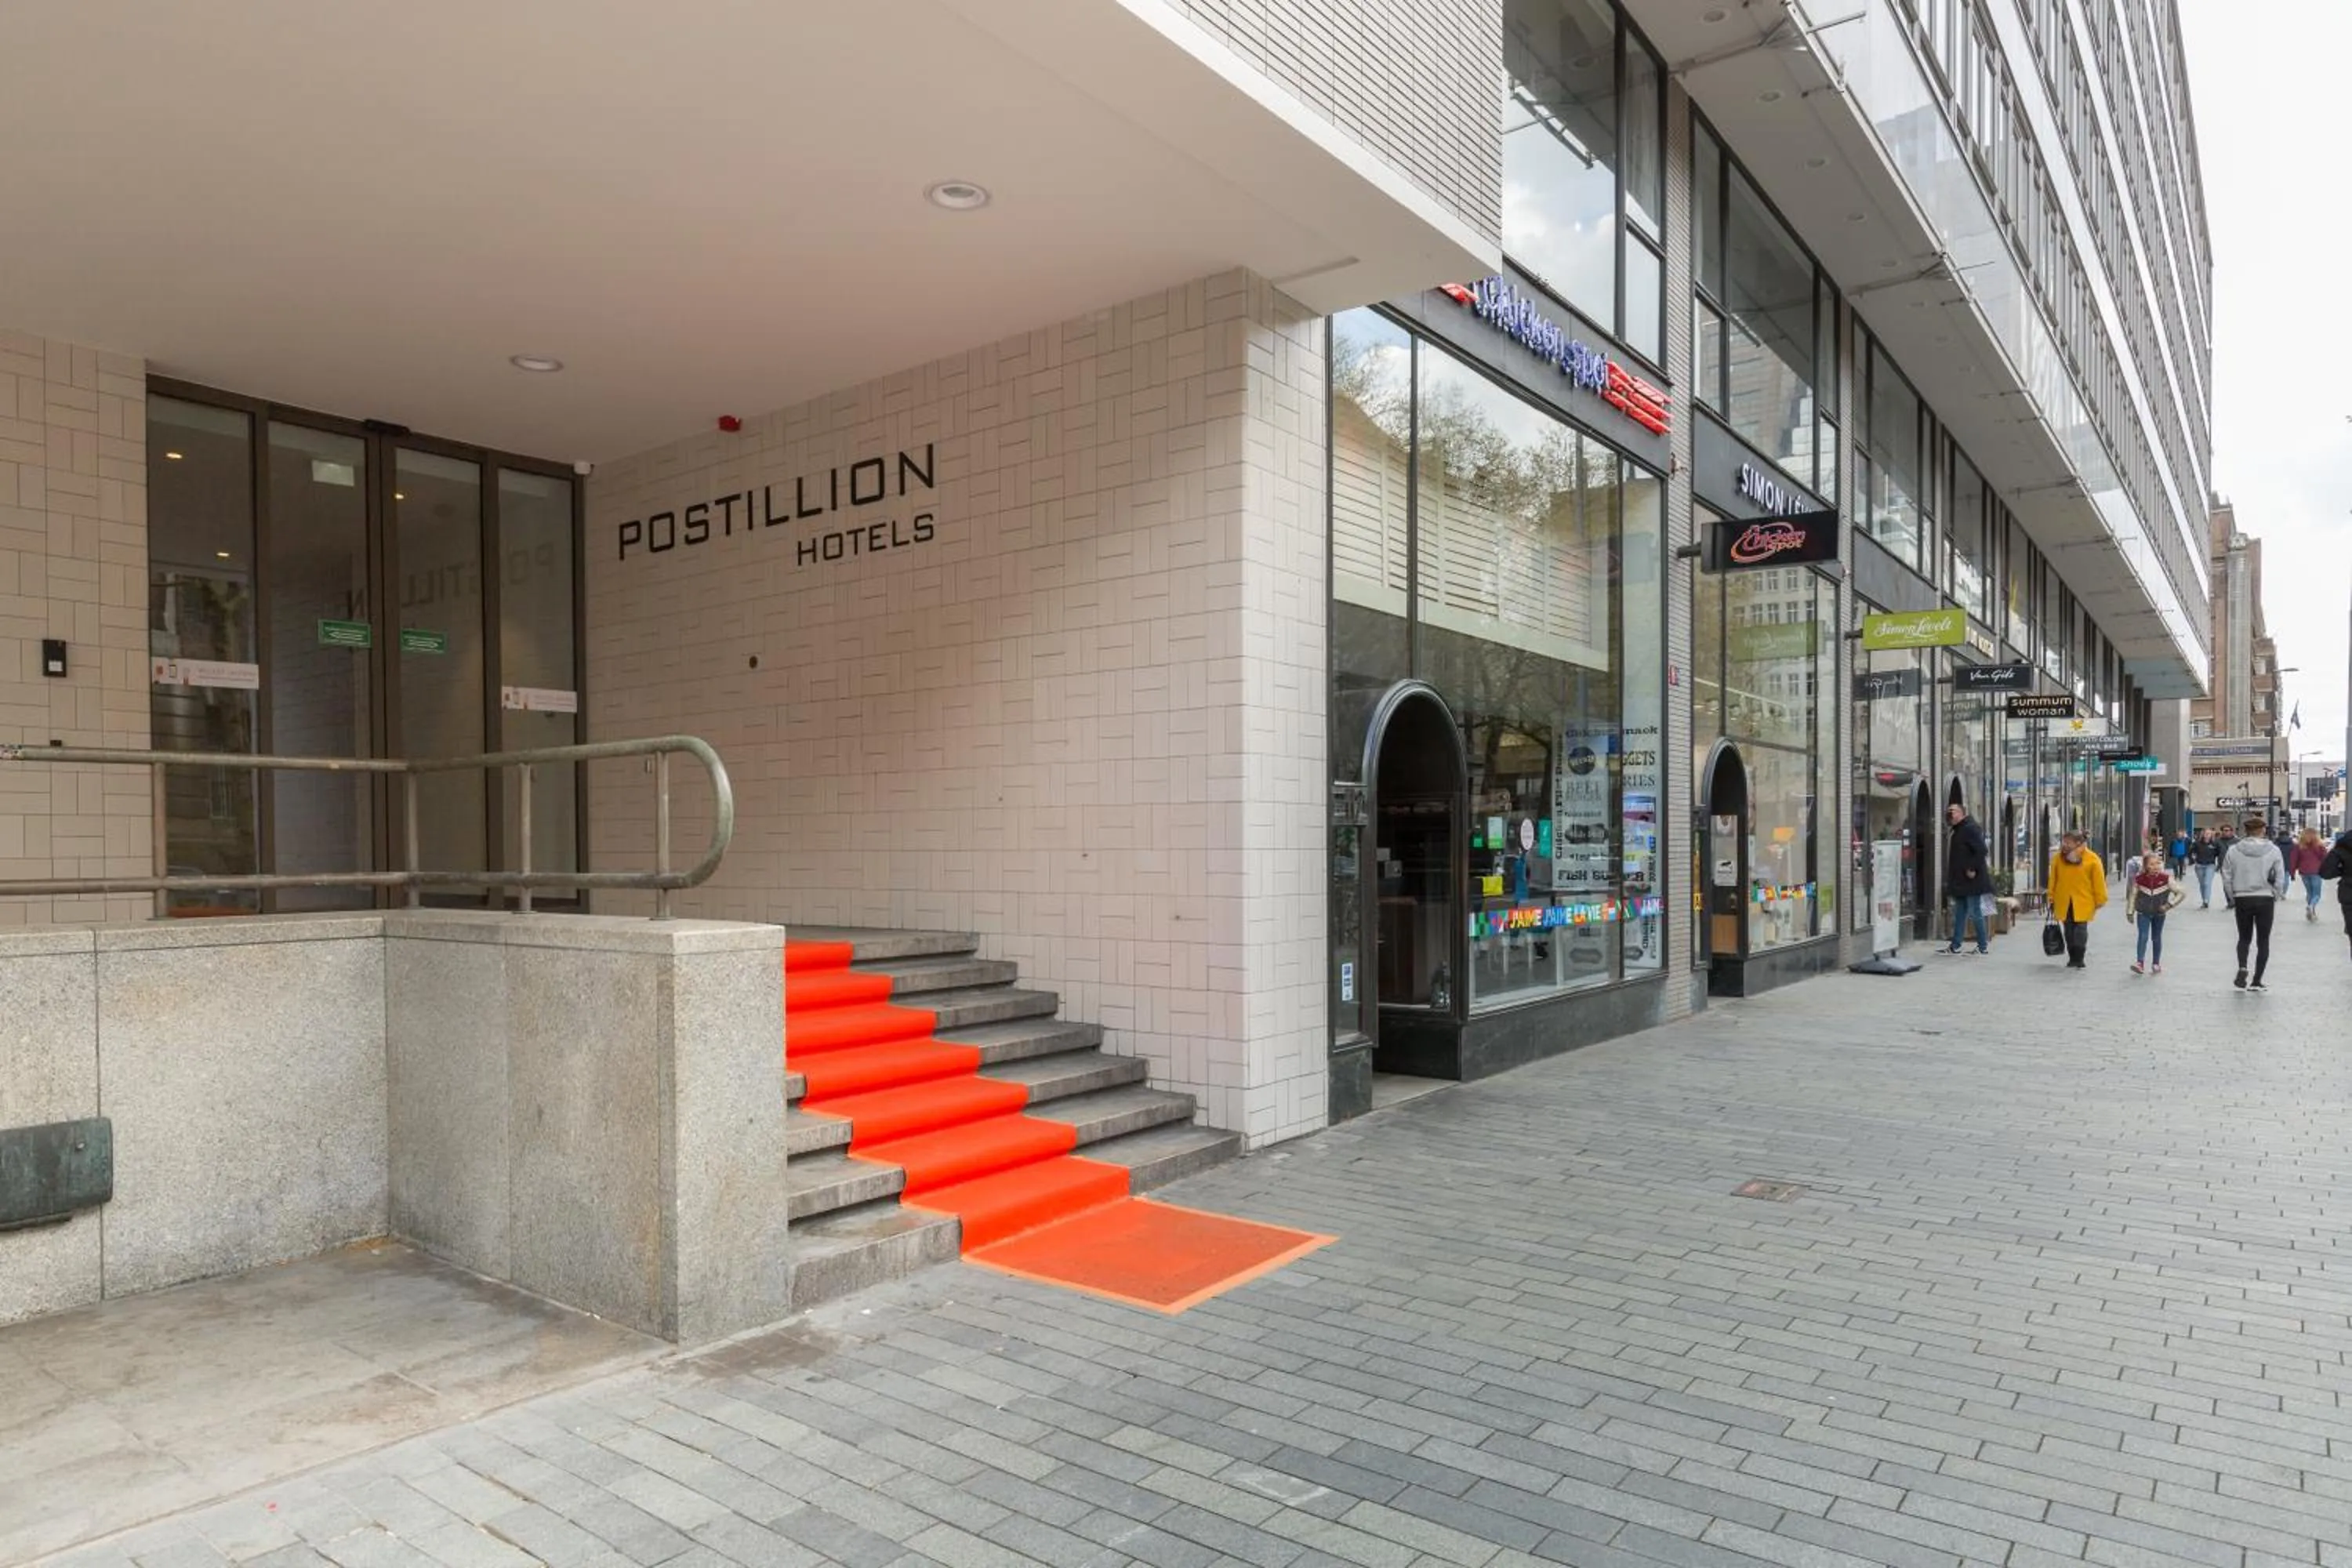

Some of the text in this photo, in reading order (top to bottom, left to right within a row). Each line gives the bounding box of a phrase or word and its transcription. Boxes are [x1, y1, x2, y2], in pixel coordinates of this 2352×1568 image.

[618, 444, 935, 561] POSTILLION
[1741, 463, 1784, 516] SIMON
[797, 514, 935, 566] HOTELS
[2011, 696, 2072, 706] summum
[2016, 707, 2067, 716] woman
